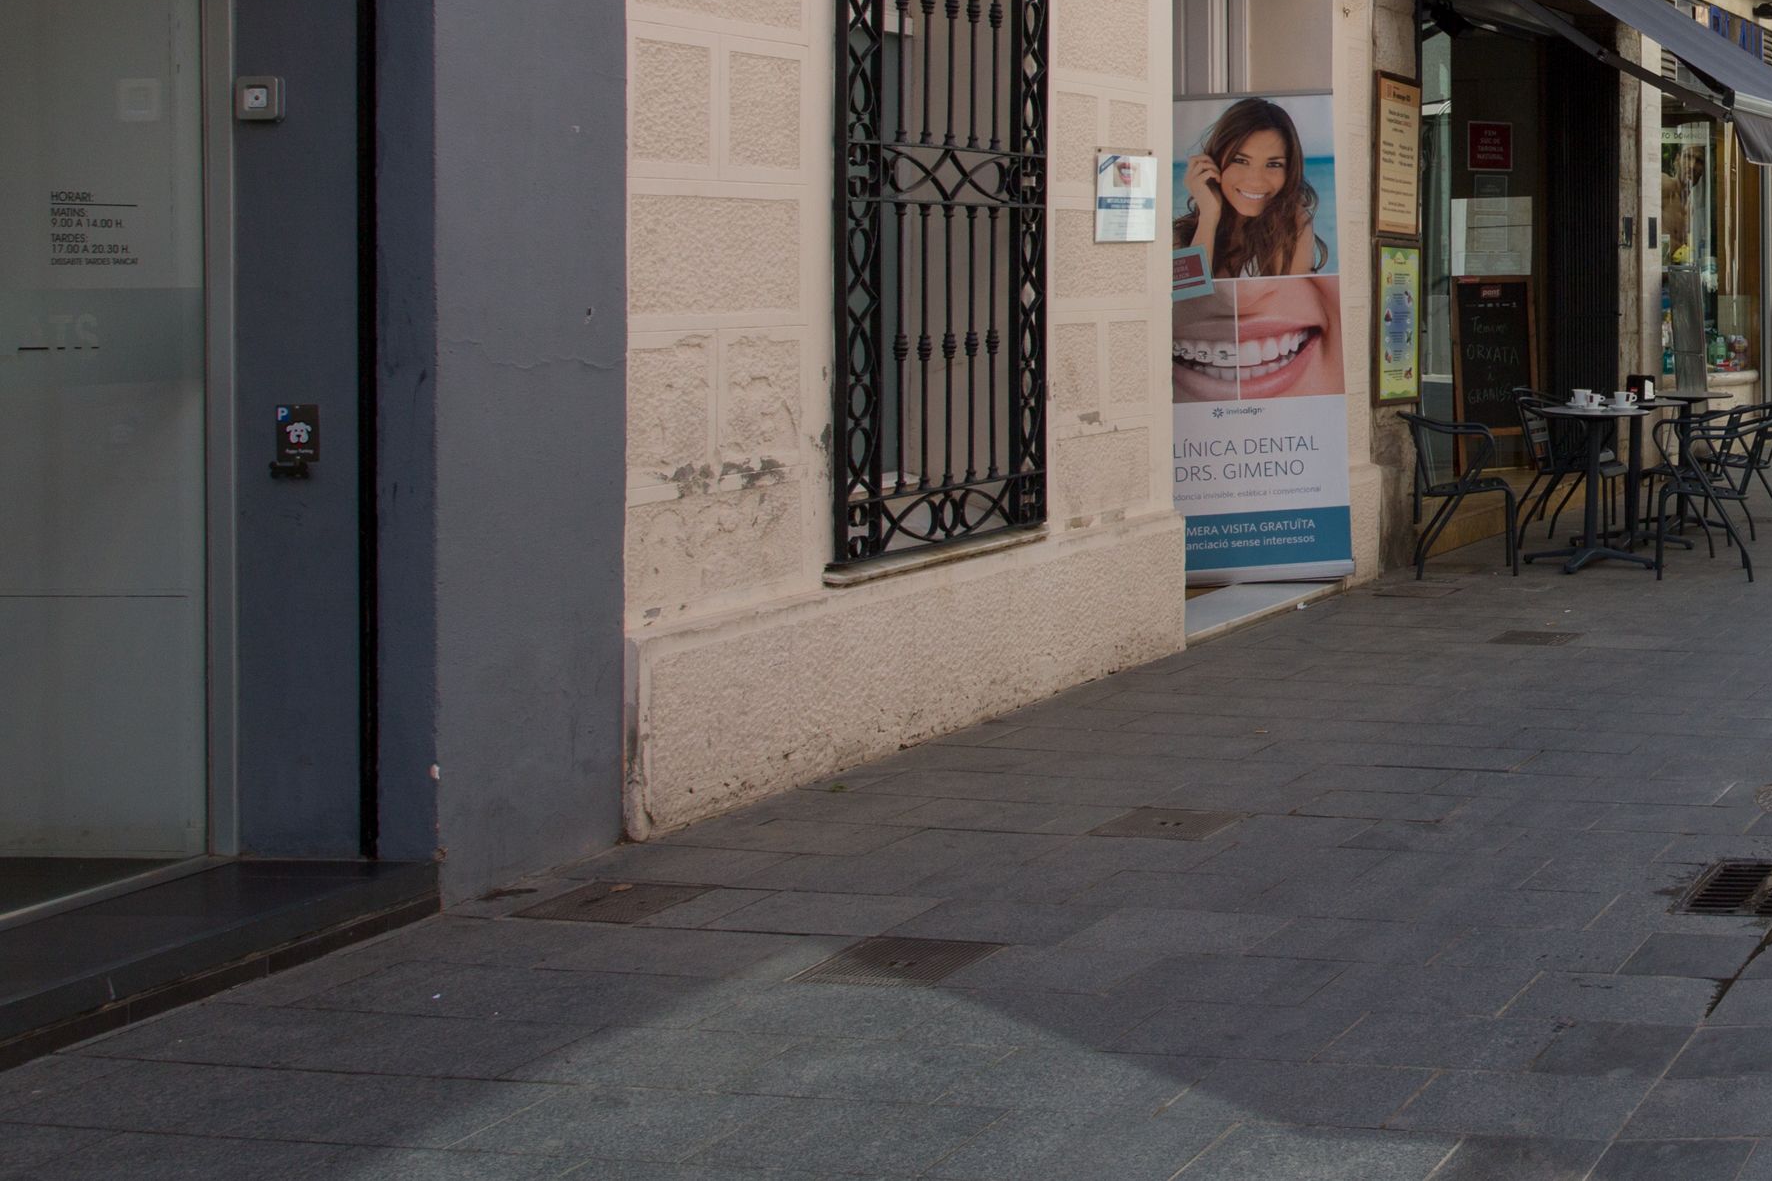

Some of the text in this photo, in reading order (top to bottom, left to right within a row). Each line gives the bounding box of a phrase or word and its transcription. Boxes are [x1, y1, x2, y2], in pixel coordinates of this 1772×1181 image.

[50, 191, 94, 202] HORARI:
[50, 207, 88, 217] MATINS:
[51, 218, 74, 227] 9.00
[75, 218, 83, 227] A
[86, 218, 113, 228] 14.00
[50, 233, 88, 243] TARDES:
[52, 244, 80, 253] 17.00
[81, 244, 89, 253] A
[91, 244, 119, 253] 20.30
[1226, 406, 1263, 416] invisalign
[1244, 435, 1319, 455] DENTAL
[1175, 459, 1305, 483] DRS. GIMENO
[1186, 518, 1316, 537] MERA VISITA GRATUÏTA
[1186, 533, 1316, 551] anciació sense interessos
